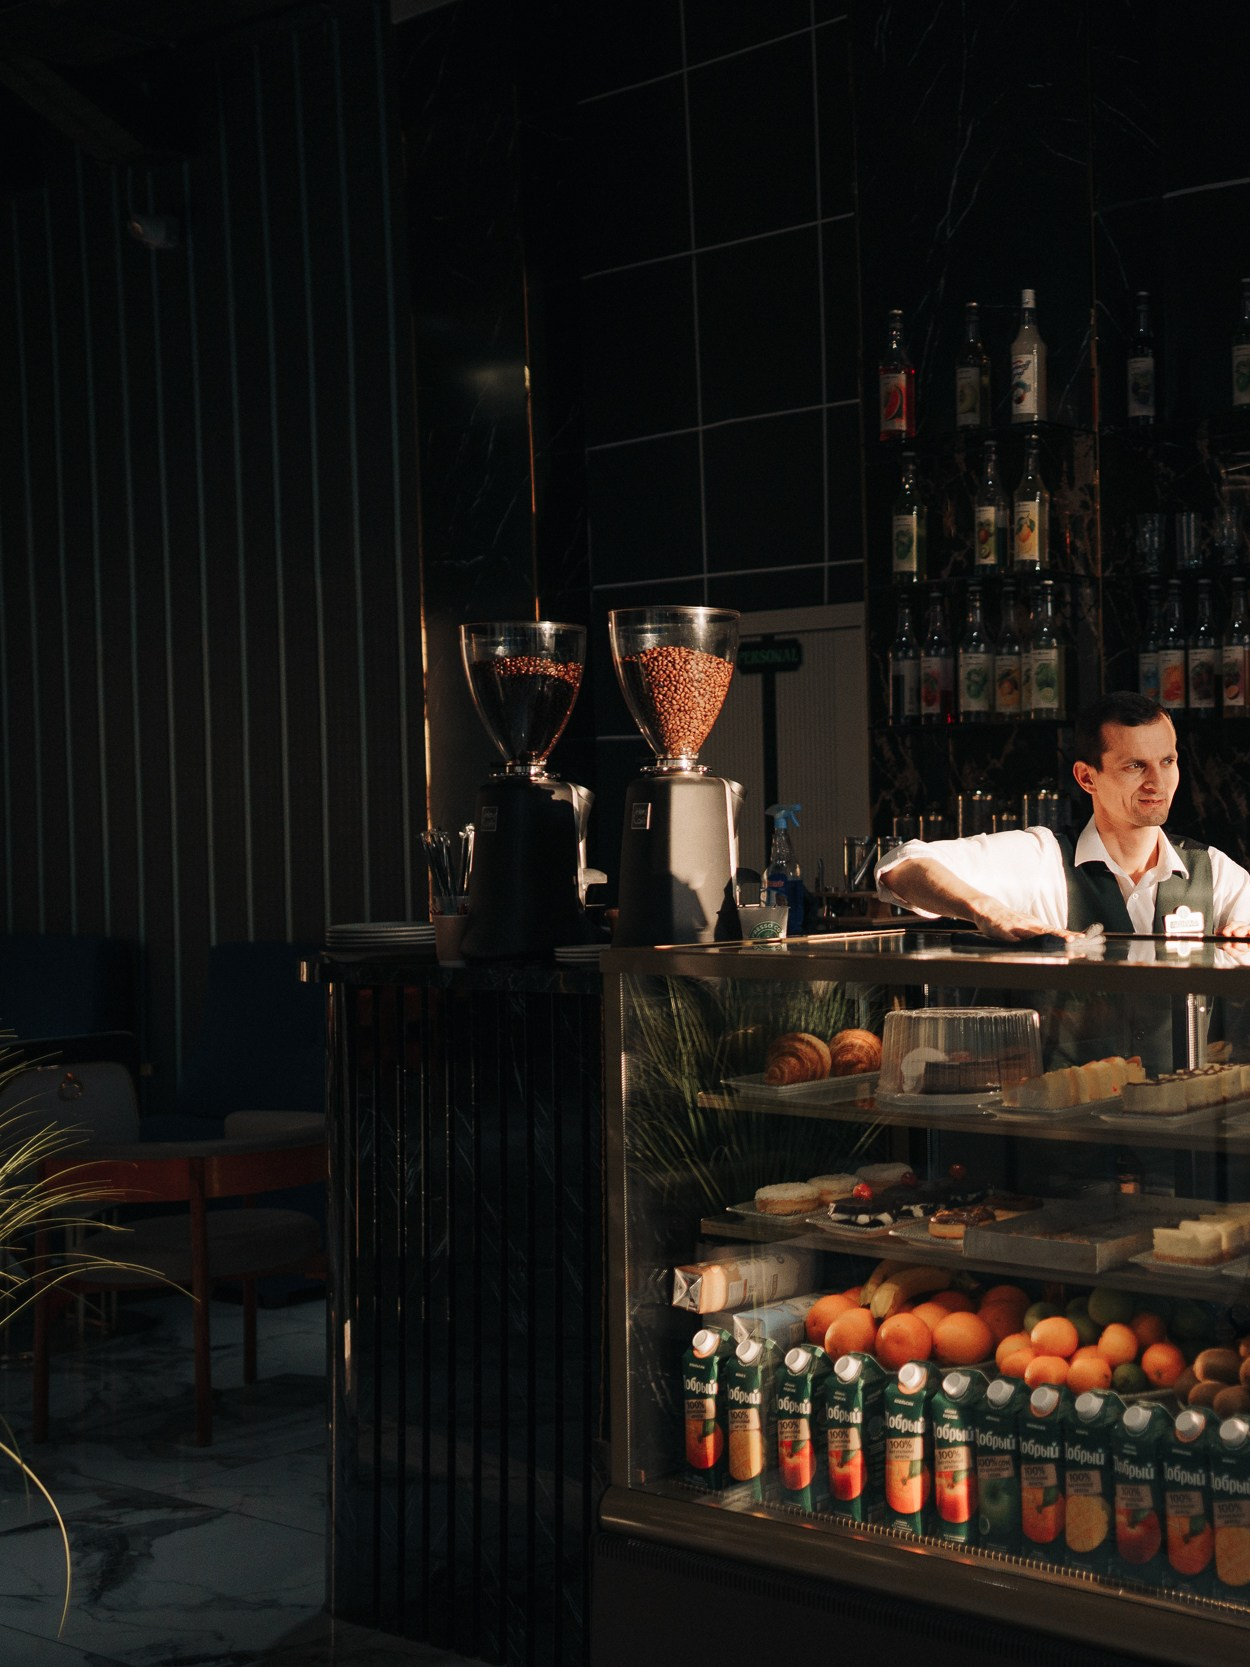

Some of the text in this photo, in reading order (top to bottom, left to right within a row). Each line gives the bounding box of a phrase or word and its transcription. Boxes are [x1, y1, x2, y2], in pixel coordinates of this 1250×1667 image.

[779, 1421, 799, 1430] 100%
[890, 1440, 912, 1449] 100%
[938, 1450, 960, 1460] 100%
[978, 1457, 997, 1467] 00%
[1069, 1472, 1091, 1482] 100%
